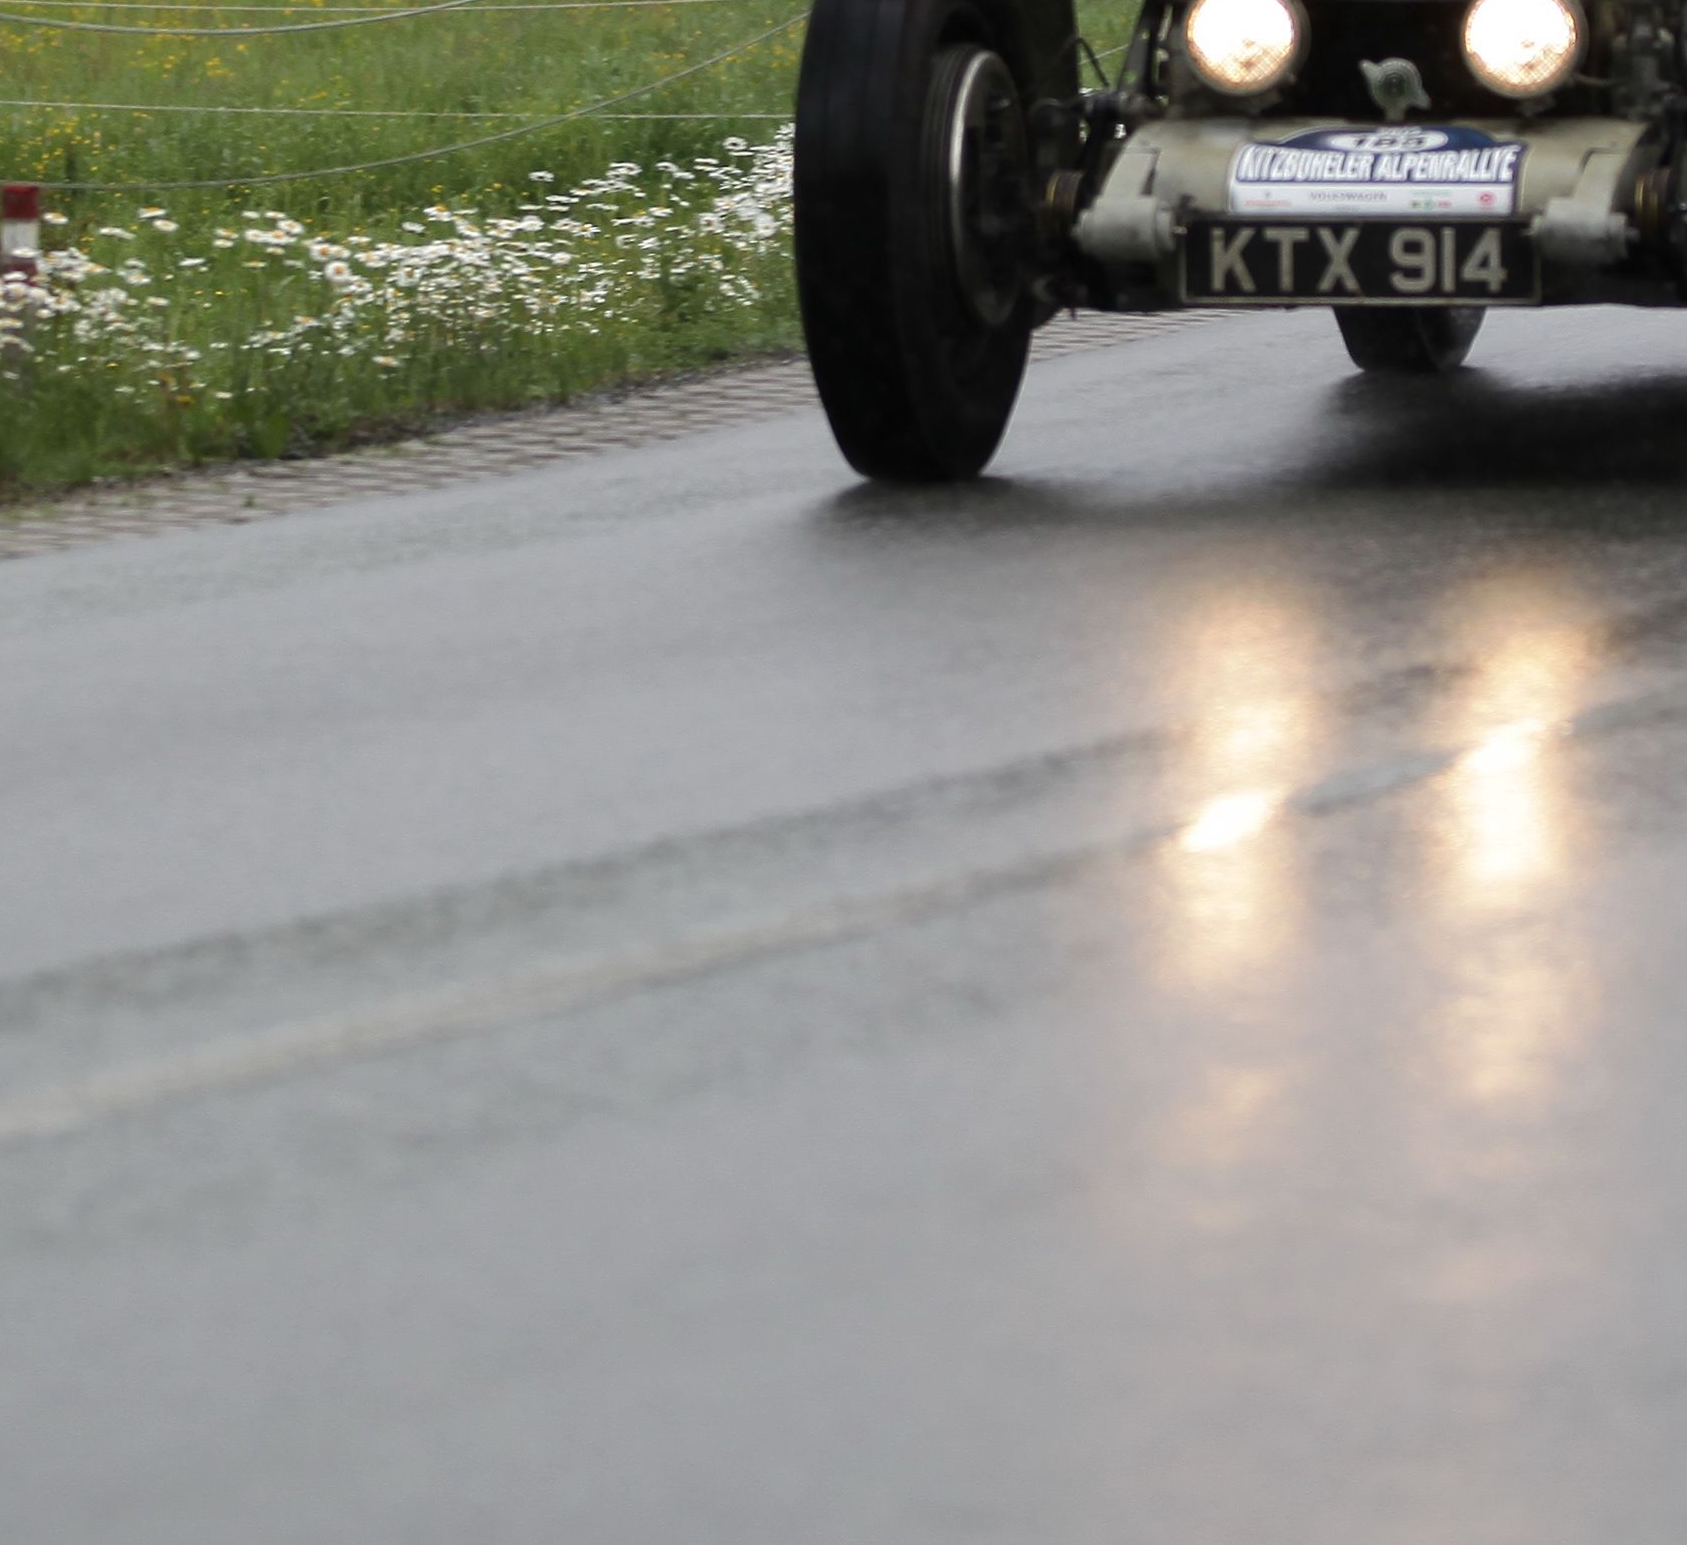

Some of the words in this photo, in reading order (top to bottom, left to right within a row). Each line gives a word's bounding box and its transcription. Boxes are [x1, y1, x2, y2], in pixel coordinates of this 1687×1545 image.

[1374, 144, 1520, 182] ALPENRALLYE
[1210, 226, 1363, 293] KTX
[1388, 226, 1508, 293] 914
